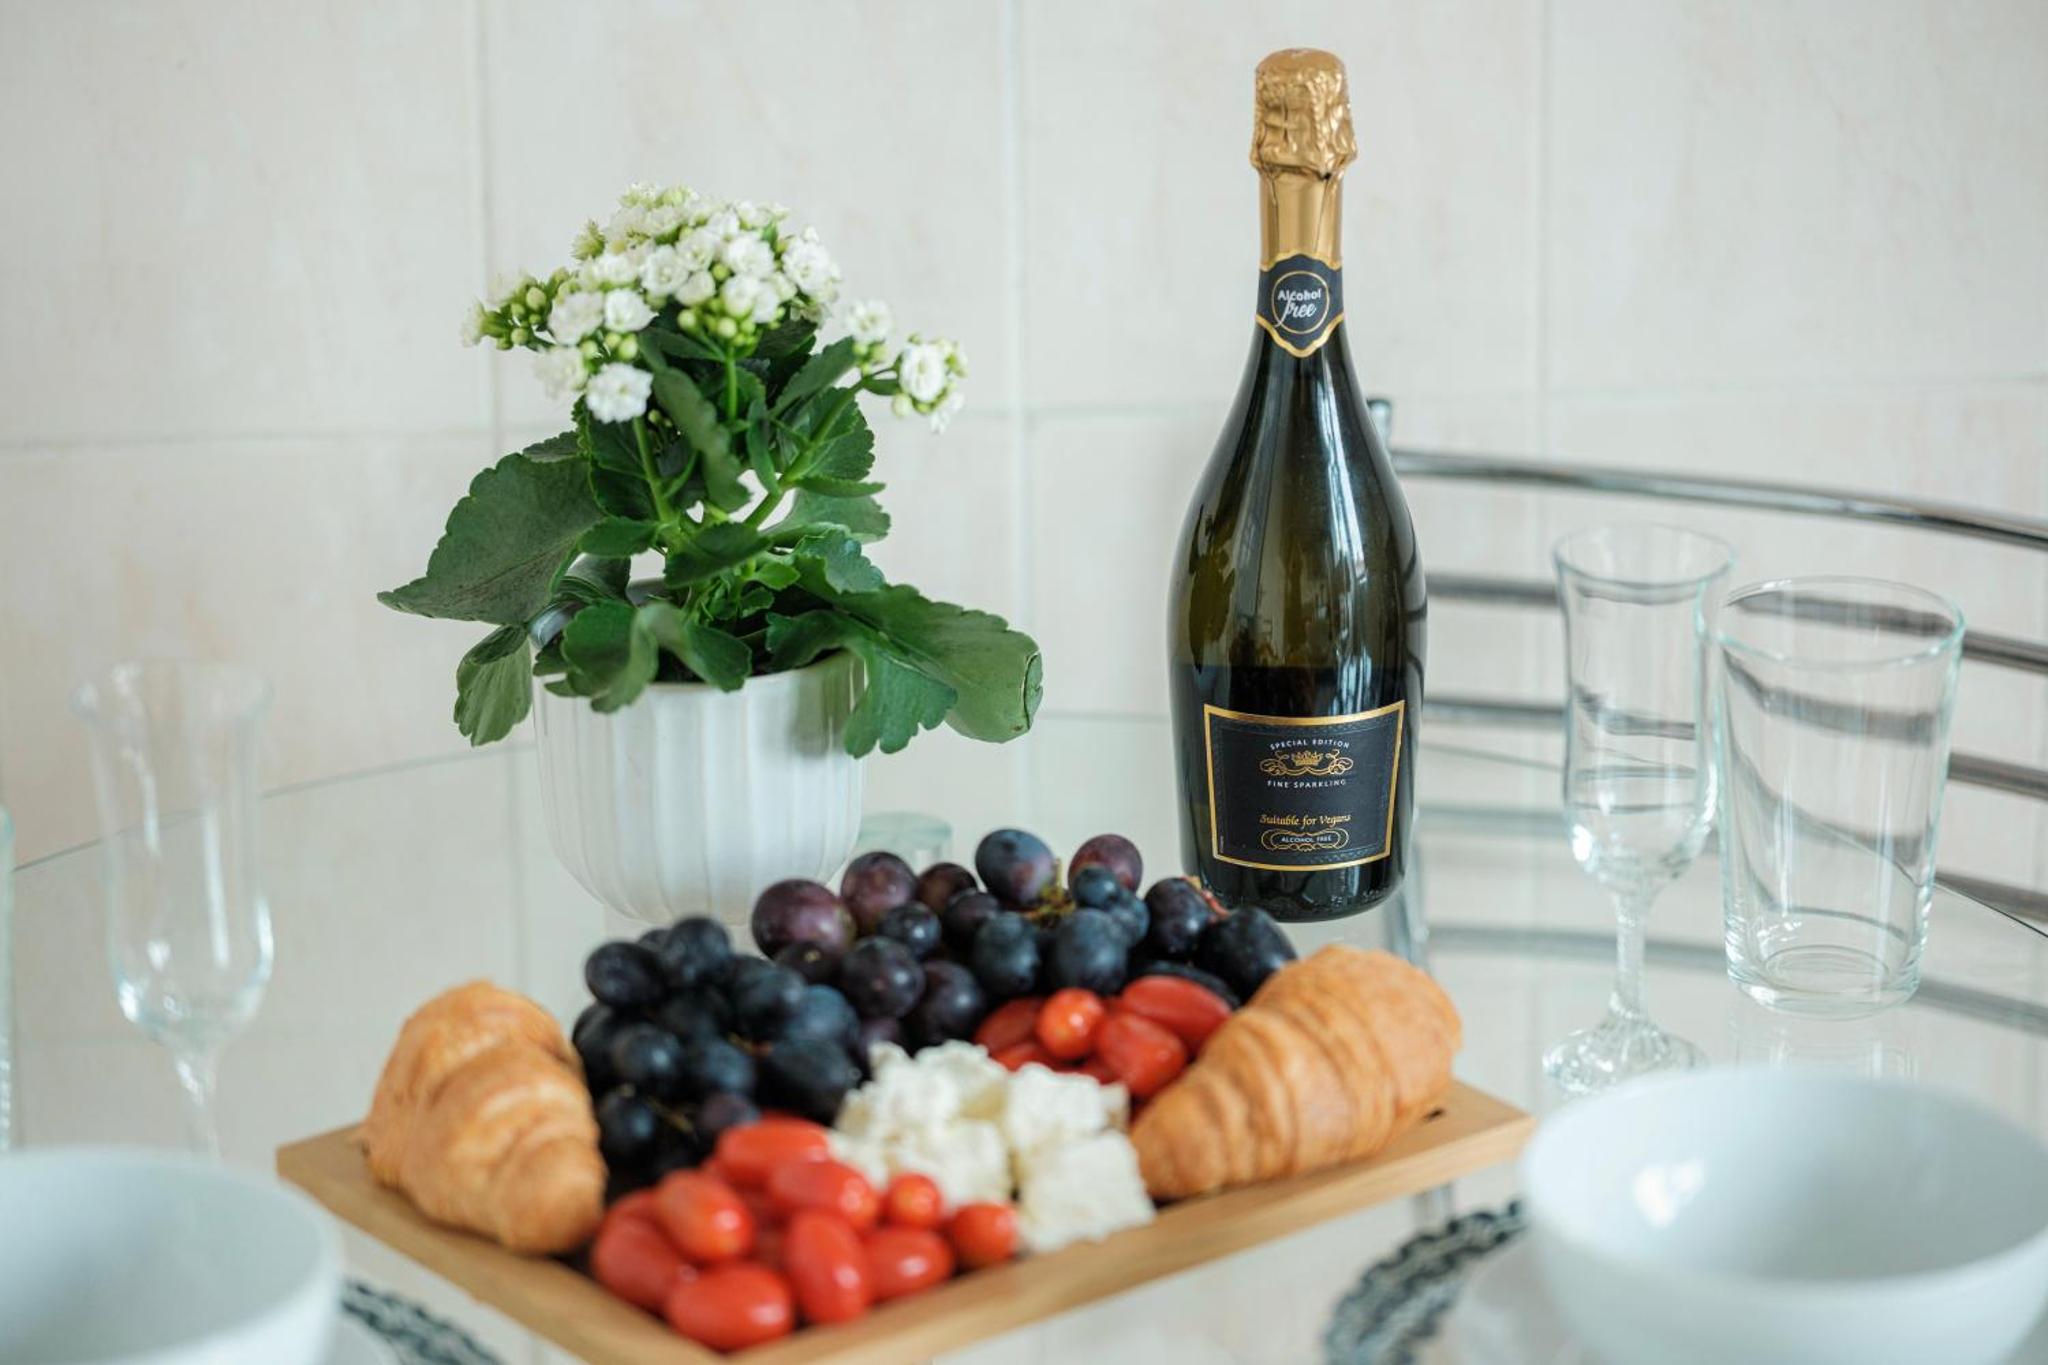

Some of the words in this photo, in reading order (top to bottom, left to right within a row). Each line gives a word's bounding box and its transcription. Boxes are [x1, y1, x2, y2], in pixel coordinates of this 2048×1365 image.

[1277, 288, 1322, 302] Alcohol
[1274, 290, 1317, 328] free
[1269, 739, 1308, 751] SPECIAL
[1312, 739, 1350, 749] EDITION
[1267, 780, 1289, 789] FINE
[1294, 779, 1346, 789] SPARKLING
[1260, 814, 1299, 826] Suitable
[1301, 814, 1317, 830] for
[1319, 814, 1352, 828] Vegans
